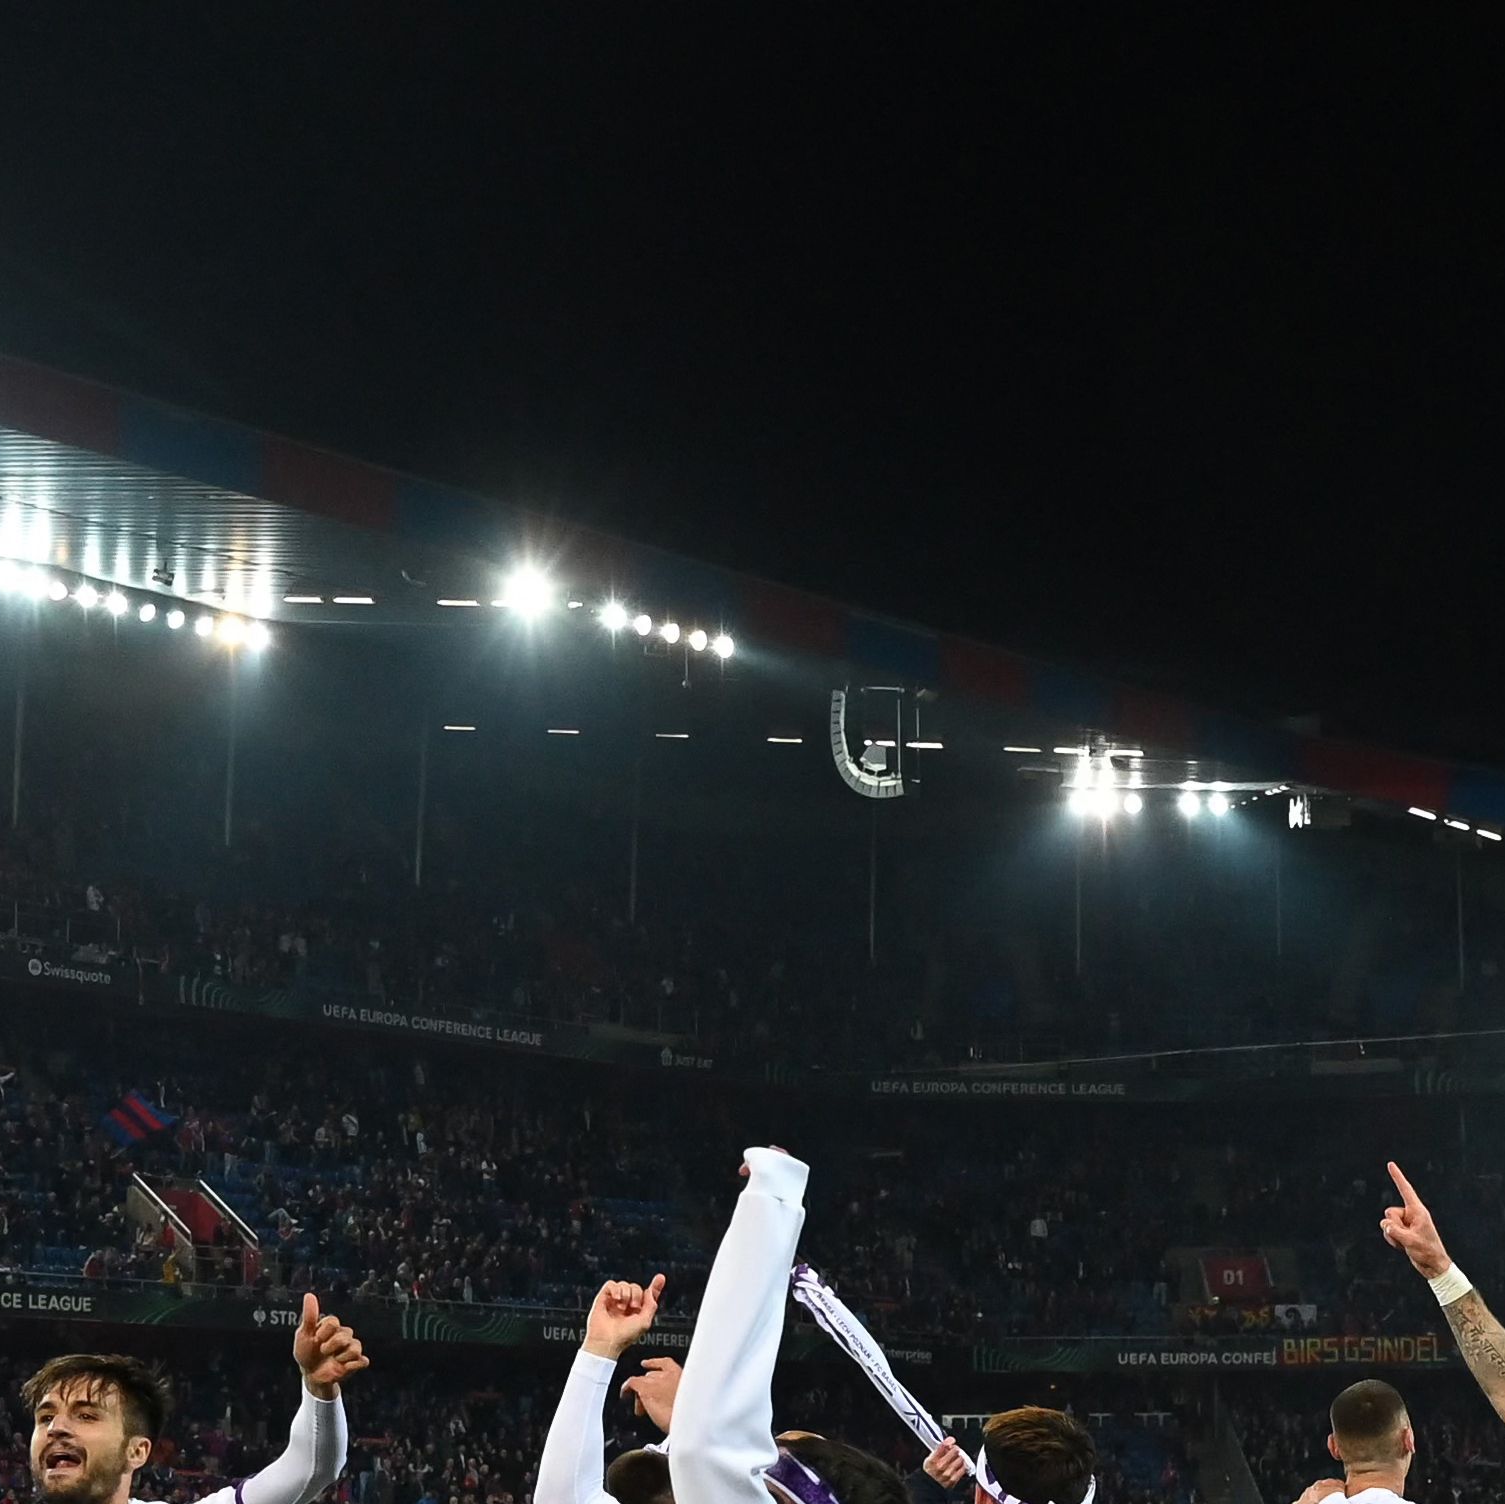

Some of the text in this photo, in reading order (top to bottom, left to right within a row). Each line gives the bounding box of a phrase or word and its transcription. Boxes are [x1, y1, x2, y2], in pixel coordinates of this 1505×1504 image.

[43, 960, 112, 985] Swissquote
[323, 1003, 544, 1047] UEFA EUROPA CONFERENCE LEAGUE
[871, 1080, 1126, 1097] UEFA EUROPA CONFERENCE LEAGUE
[29, 1293, 93, 1313] LEAGUE
[543, 1326, 577, 1341] UEFA
[1117, 1352, 1157, 1366] UEFA
[1160, 1352, 1218, 1366] EUROPA
